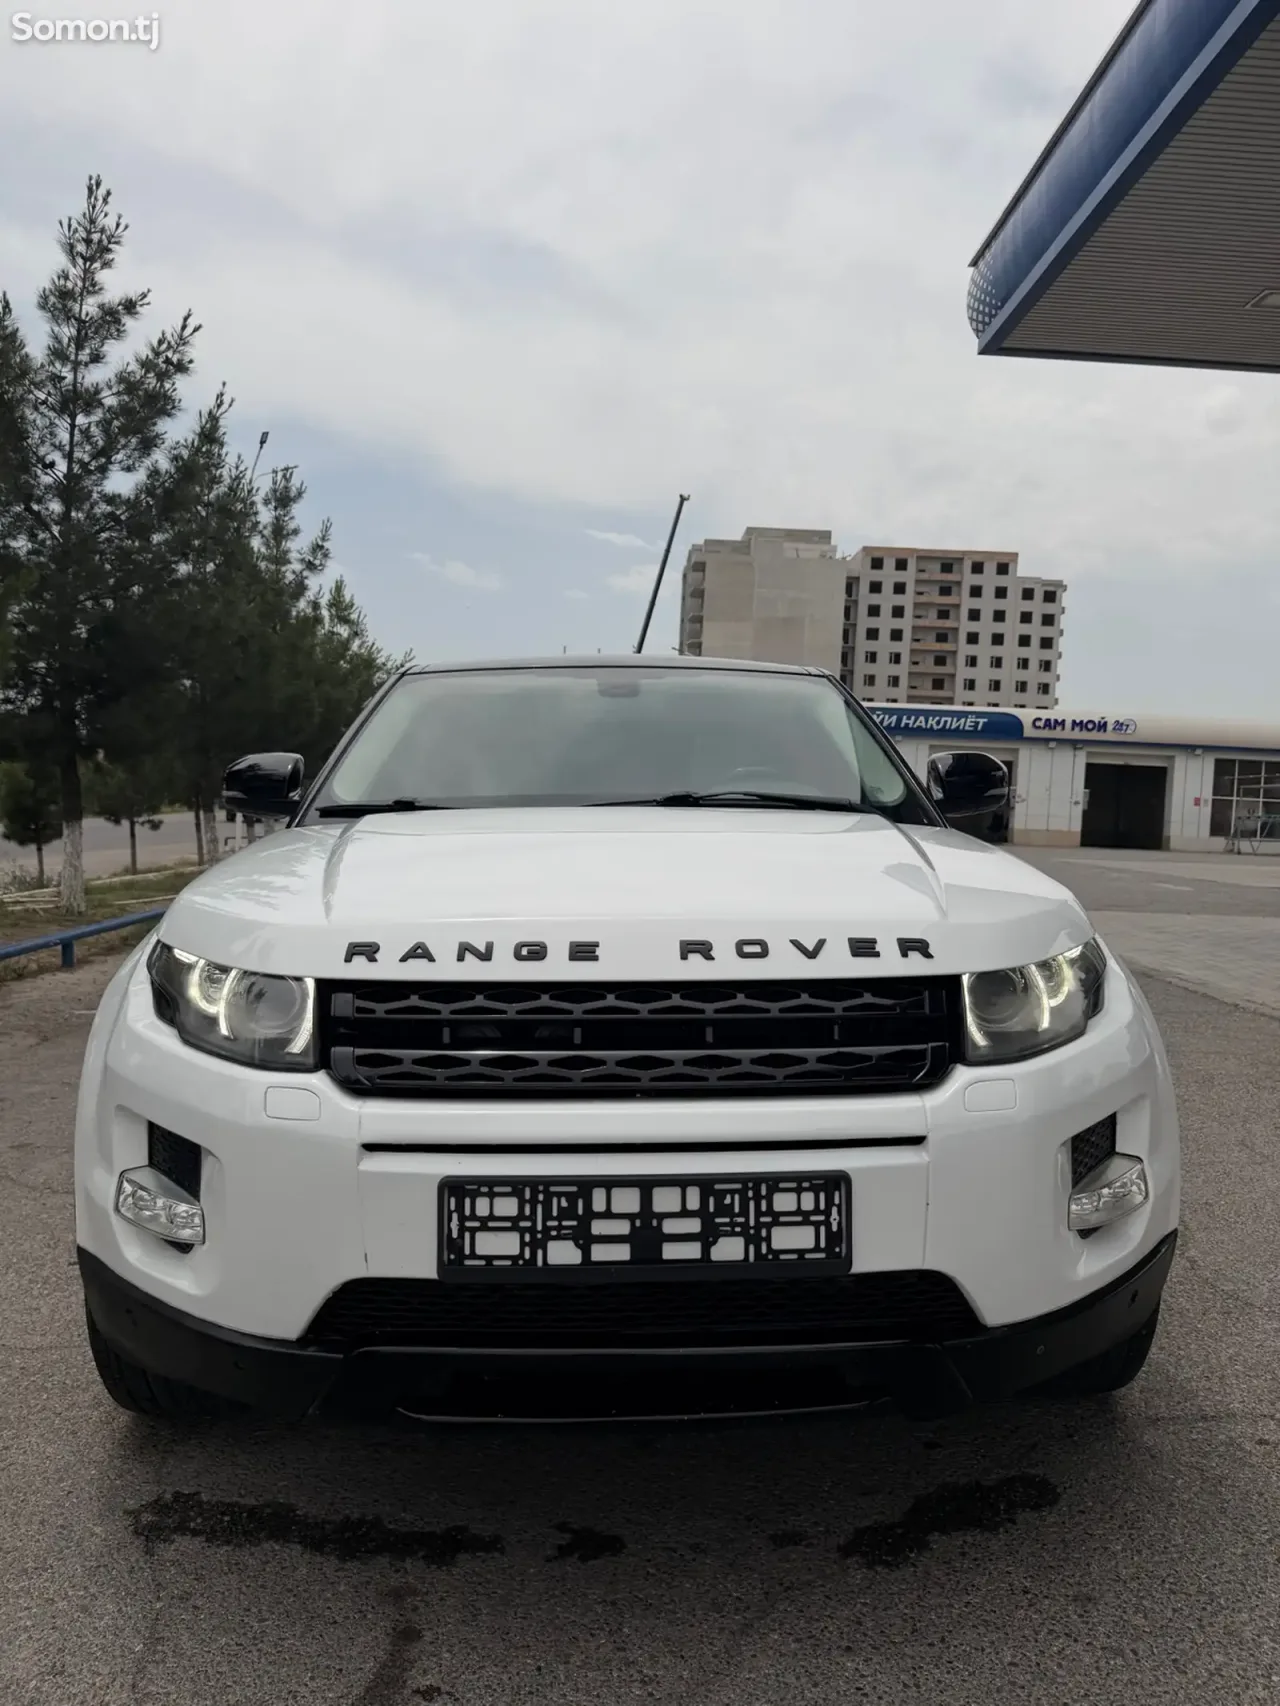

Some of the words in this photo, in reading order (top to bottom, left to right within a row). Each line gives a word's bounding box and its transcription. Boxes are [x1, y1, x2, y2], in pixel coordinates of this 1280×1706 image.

[1032, 717, 1066, 731] САМ
[1071, 716, 1108, 733] МОЙ
[344, 941, 600, 963] RANGE
[679, 937, 934, 961] ROVER
